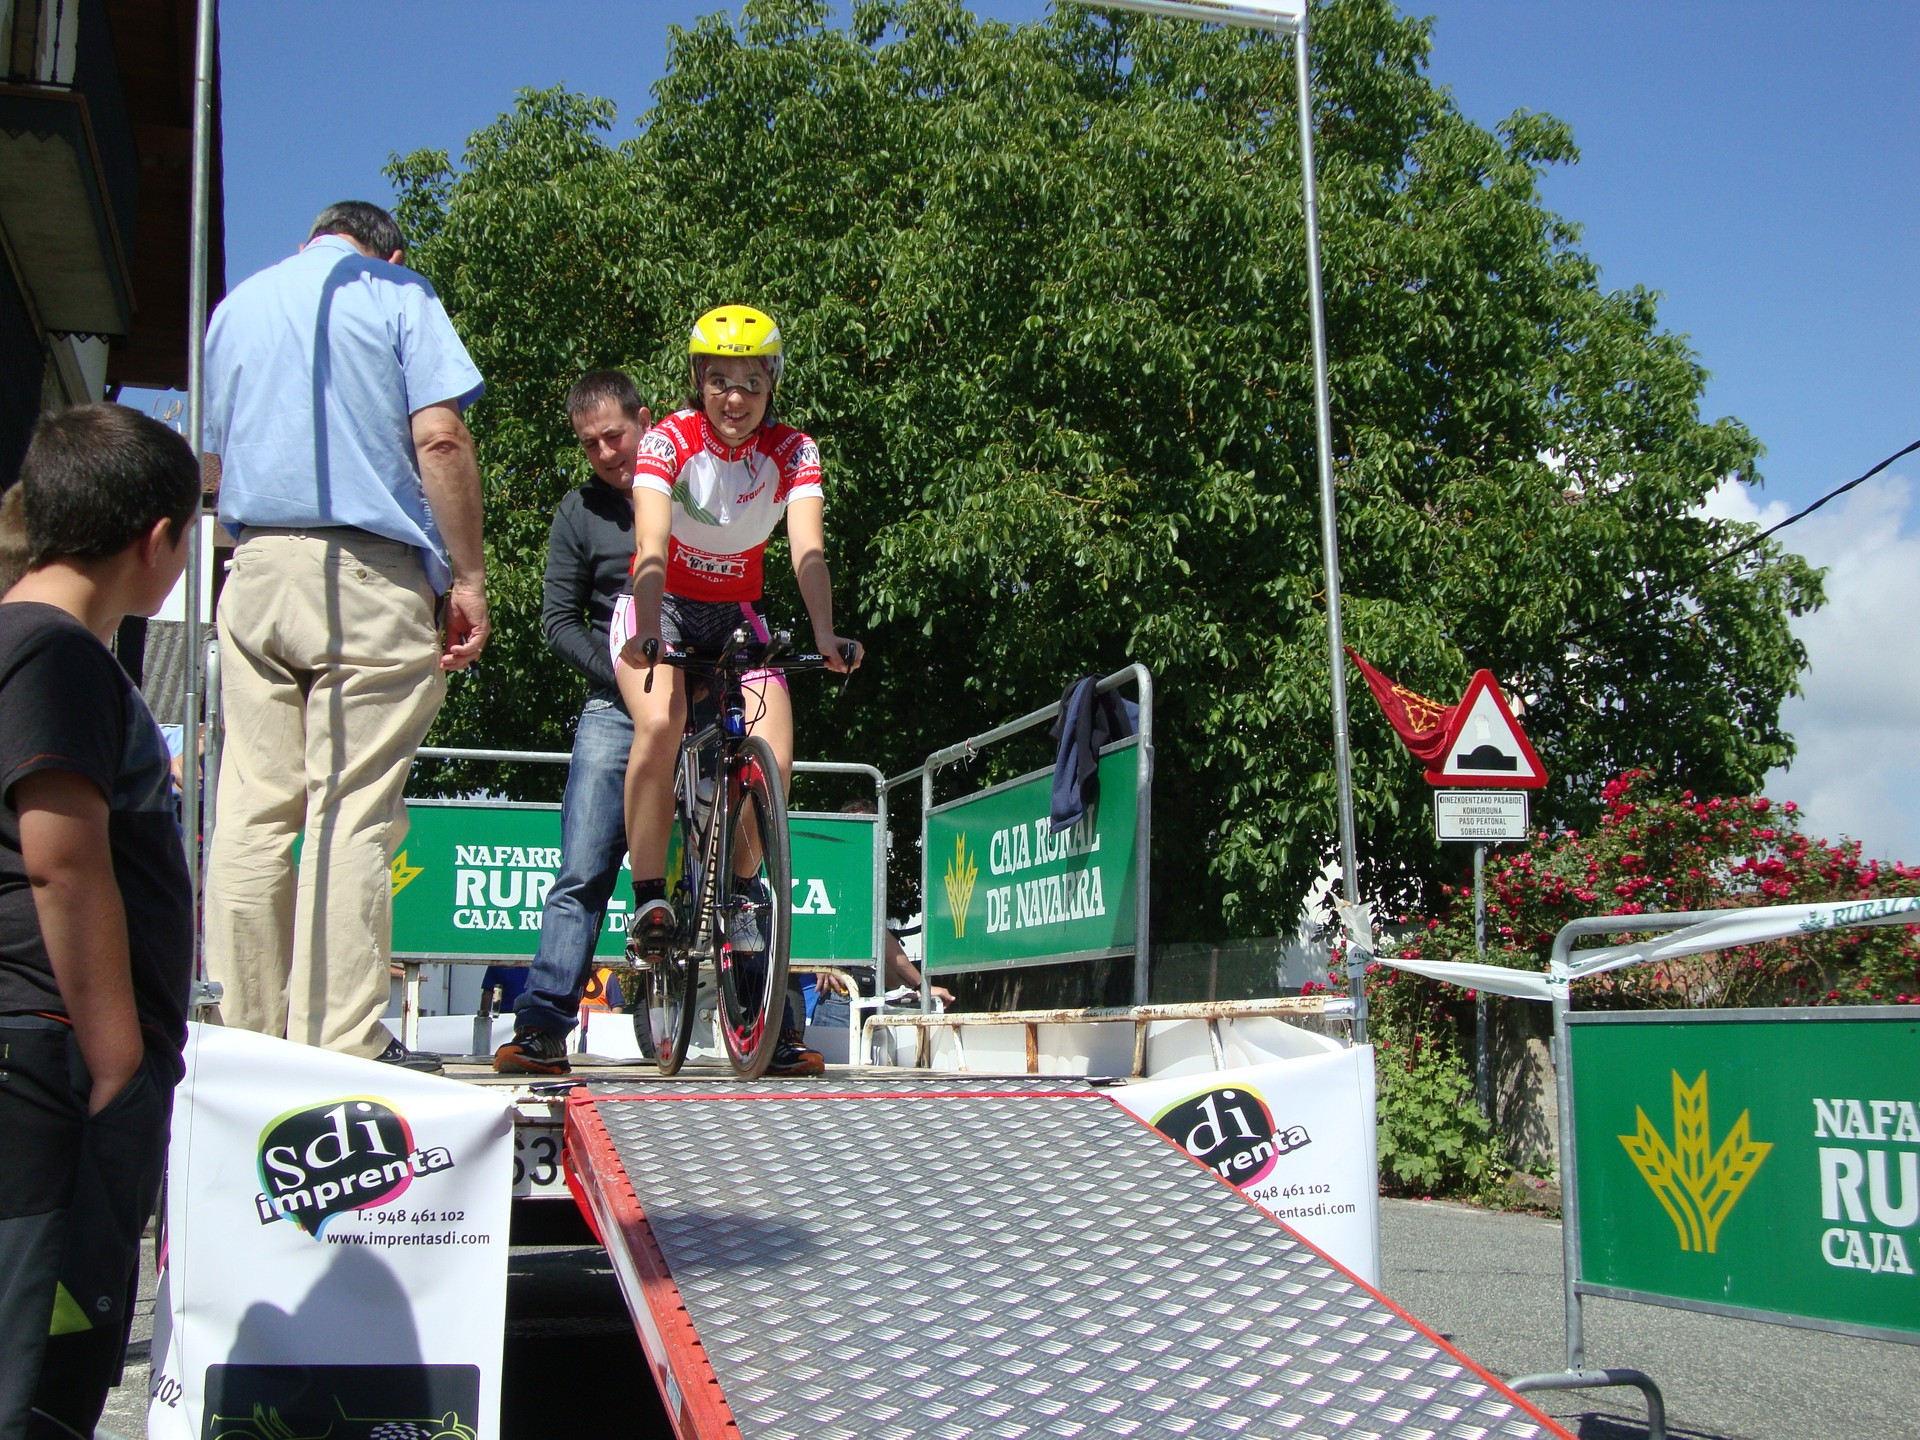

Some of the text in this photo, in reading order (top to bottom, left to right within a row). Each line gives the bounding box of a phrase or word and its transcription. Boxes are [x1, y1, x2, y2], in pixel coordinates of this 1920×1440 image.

[717, 343, 755, 352] MET
[1458, 817, 1475, 825] PASO
[1460, 828, 1507, 836] SOBREELEVADO
[990, 823, 1031, 876] CAJA
[986, 866, 1106, 933] DE NAVARRA
[453, 908, 514, 931] CAJA
[1184, 1090, 1262, 1157] di
[1813, 1098, 1920, 1143] NAFA
[265, 1102, 397, 1191] sdi
[1212, 1126, 1310, 1179] renta
[257, 1148, 454, 1222] imprenta
[1253, 1183, 1331, 1202] 948 461 102
[376, 1209, 407, 1224] 948
[410, 1209, 437, 1225] 461
[440, 1210, 465, 1222] 102
[1272, 1203, 1356, 1219] rentasdi.com
[327, 1231, 490, 1248] www.imprentasdi.com
[1821, 1227, 1915, 1275] CAJA
